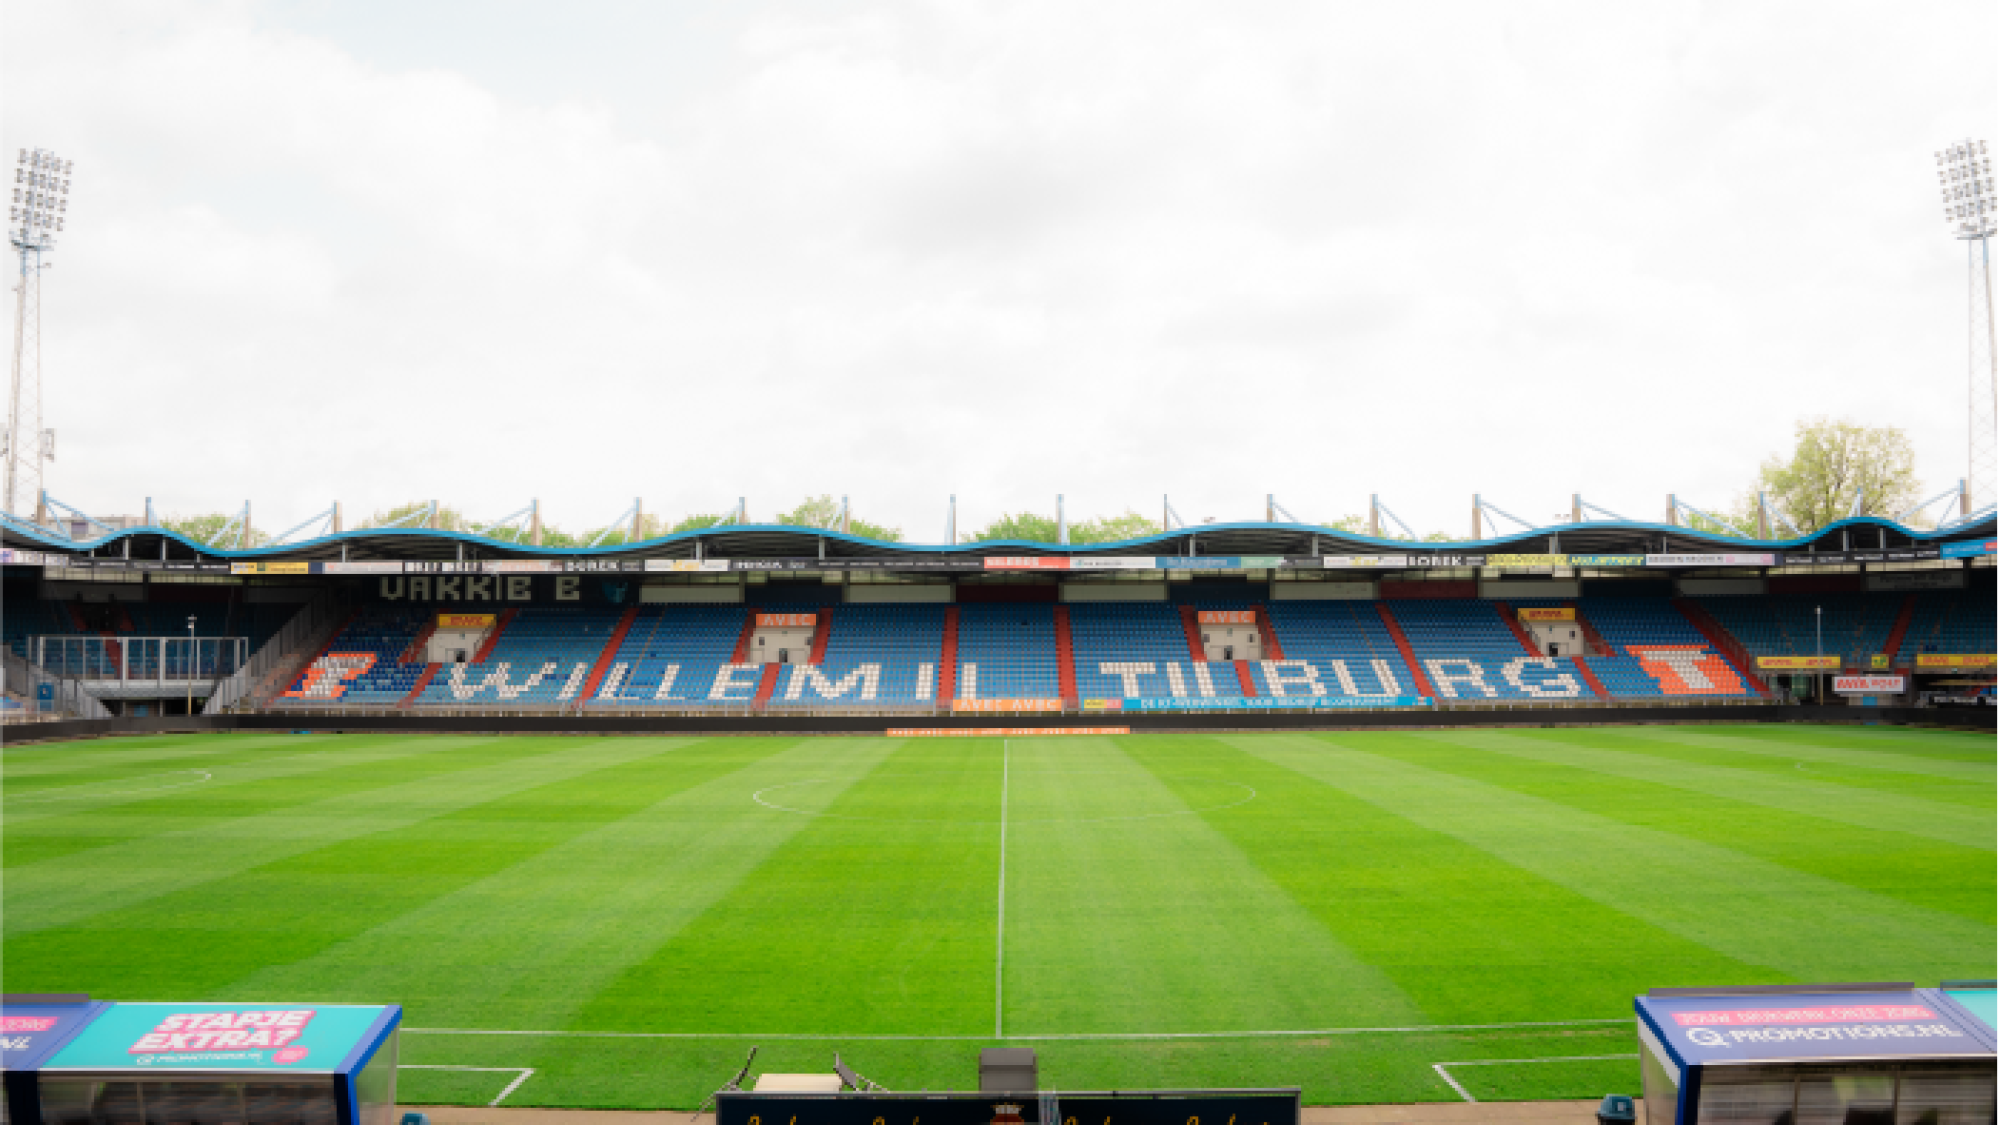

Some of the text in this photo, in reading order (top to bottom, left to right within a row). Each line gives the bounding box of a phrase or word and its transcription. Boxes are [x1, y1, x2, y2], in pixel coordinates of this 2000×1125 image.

[763, 614, 812, 627] AVEC
[1204, 611, 1252, 623] AVEC
[448, 661, 881, 701] WILLEM
[959, 699, 1058, 711] AVEC AVEC
[156, 1010, 315, 1031] STAPJE
[131, 1029, 302, 1053] EXTRA?
